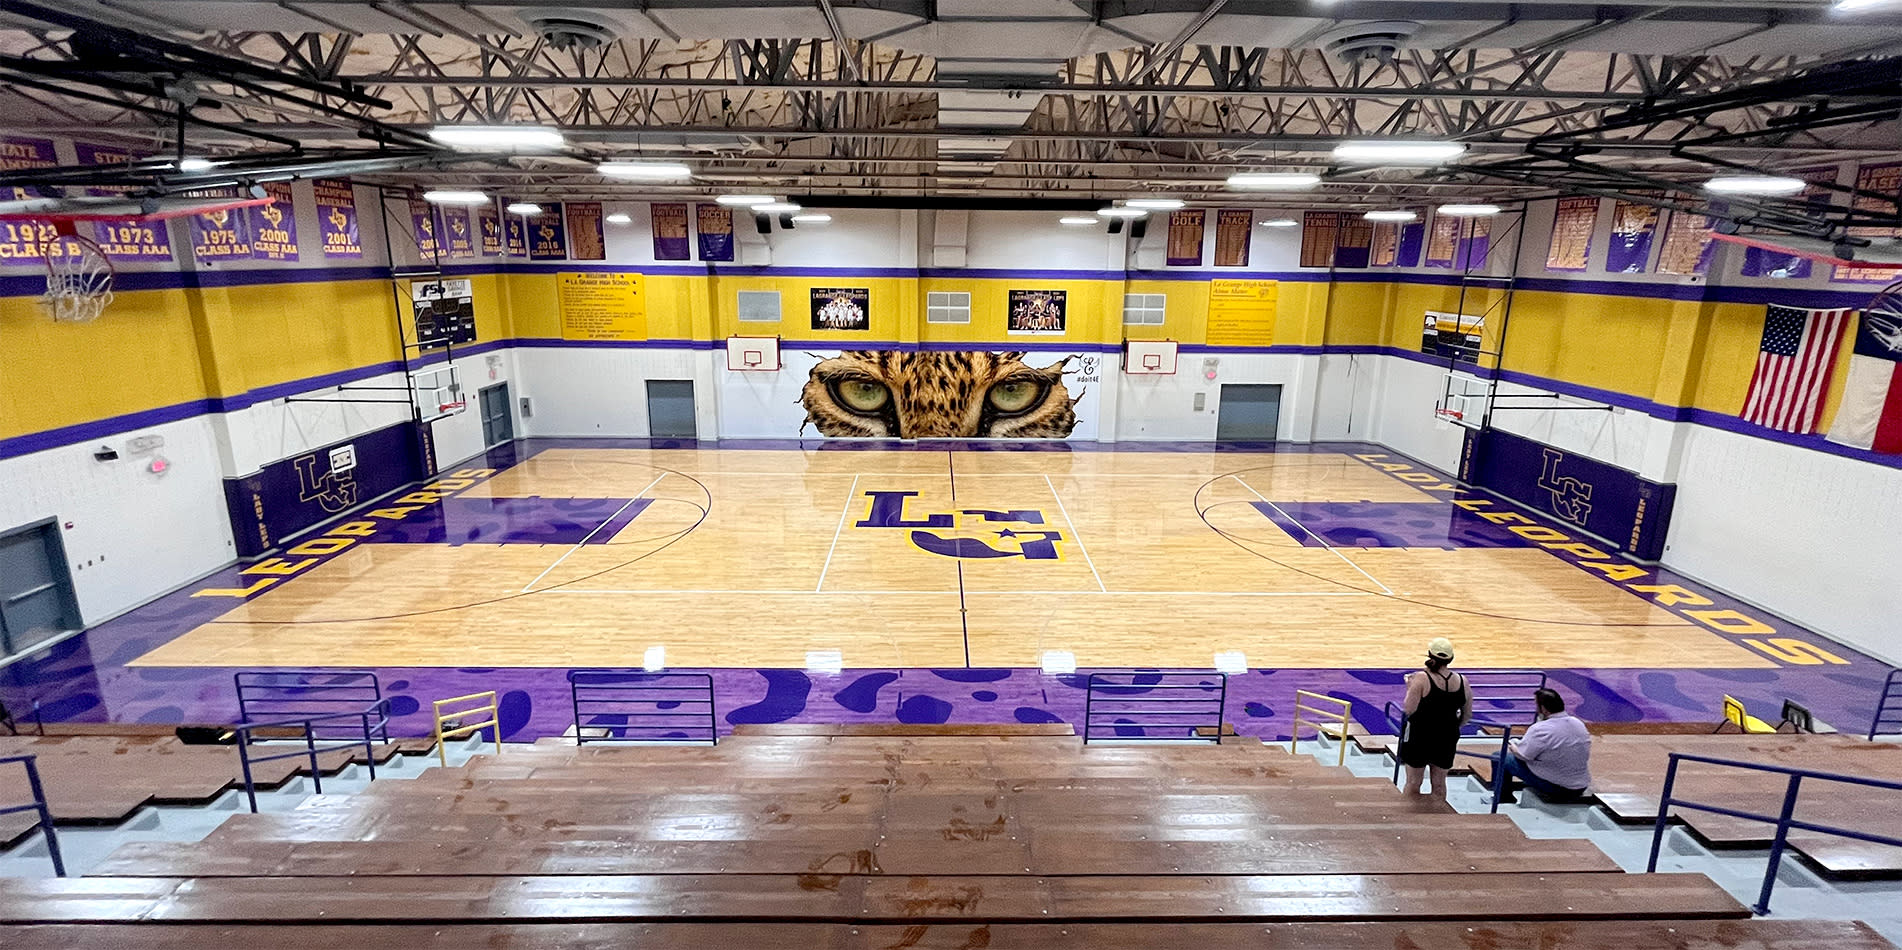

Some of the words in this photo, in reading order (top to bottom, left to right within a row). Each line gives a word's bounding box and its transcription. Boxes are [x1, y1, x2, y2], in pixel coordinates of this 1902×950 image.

[314, 186, 353, 199] CHAMPION
[1559, 199, 1598, 209] SOFTBALL
[698, 210, 731, 218] SOCCER
[1172, 216, 1201, 226] GOLF
[1220, 217, 1249, 225] TRACK
[1305, 219, 1337, 227] TENNIS
[1342, 219, 1373, 228] TENNIS
[108, 227, 154, 244] 1973
[202, 230, 237, 244] 1975
[258, 228, 289, 243] 2000
[327, 232, 352, 246] 2001
[0, 243, 63, 258] CLASS
[66, 242, 82, 257] B
[99, 243, 140, 256] CLASS
[142, 244, 170, 256] AAA
[196, 245, 231, 256] CLASS
[233, 244, 250, 254] AA
[253, 241, 279, 252] CLASS
[280, 243, 297, 254] AAA
[323, 244, 345, 253] CLASS
[345, 245, 361, 253] AAA
[537, 241, 559, 249] 2016
[253, 494, 264, 520] LADY
[1629, 498, 1647, 552] LEOPARDS
[190, 467, 498, 598] LEOPARDS
[1353, 453, 1470, 494] LADY
[1450, 499, 1851, 665] LEOPARDS
